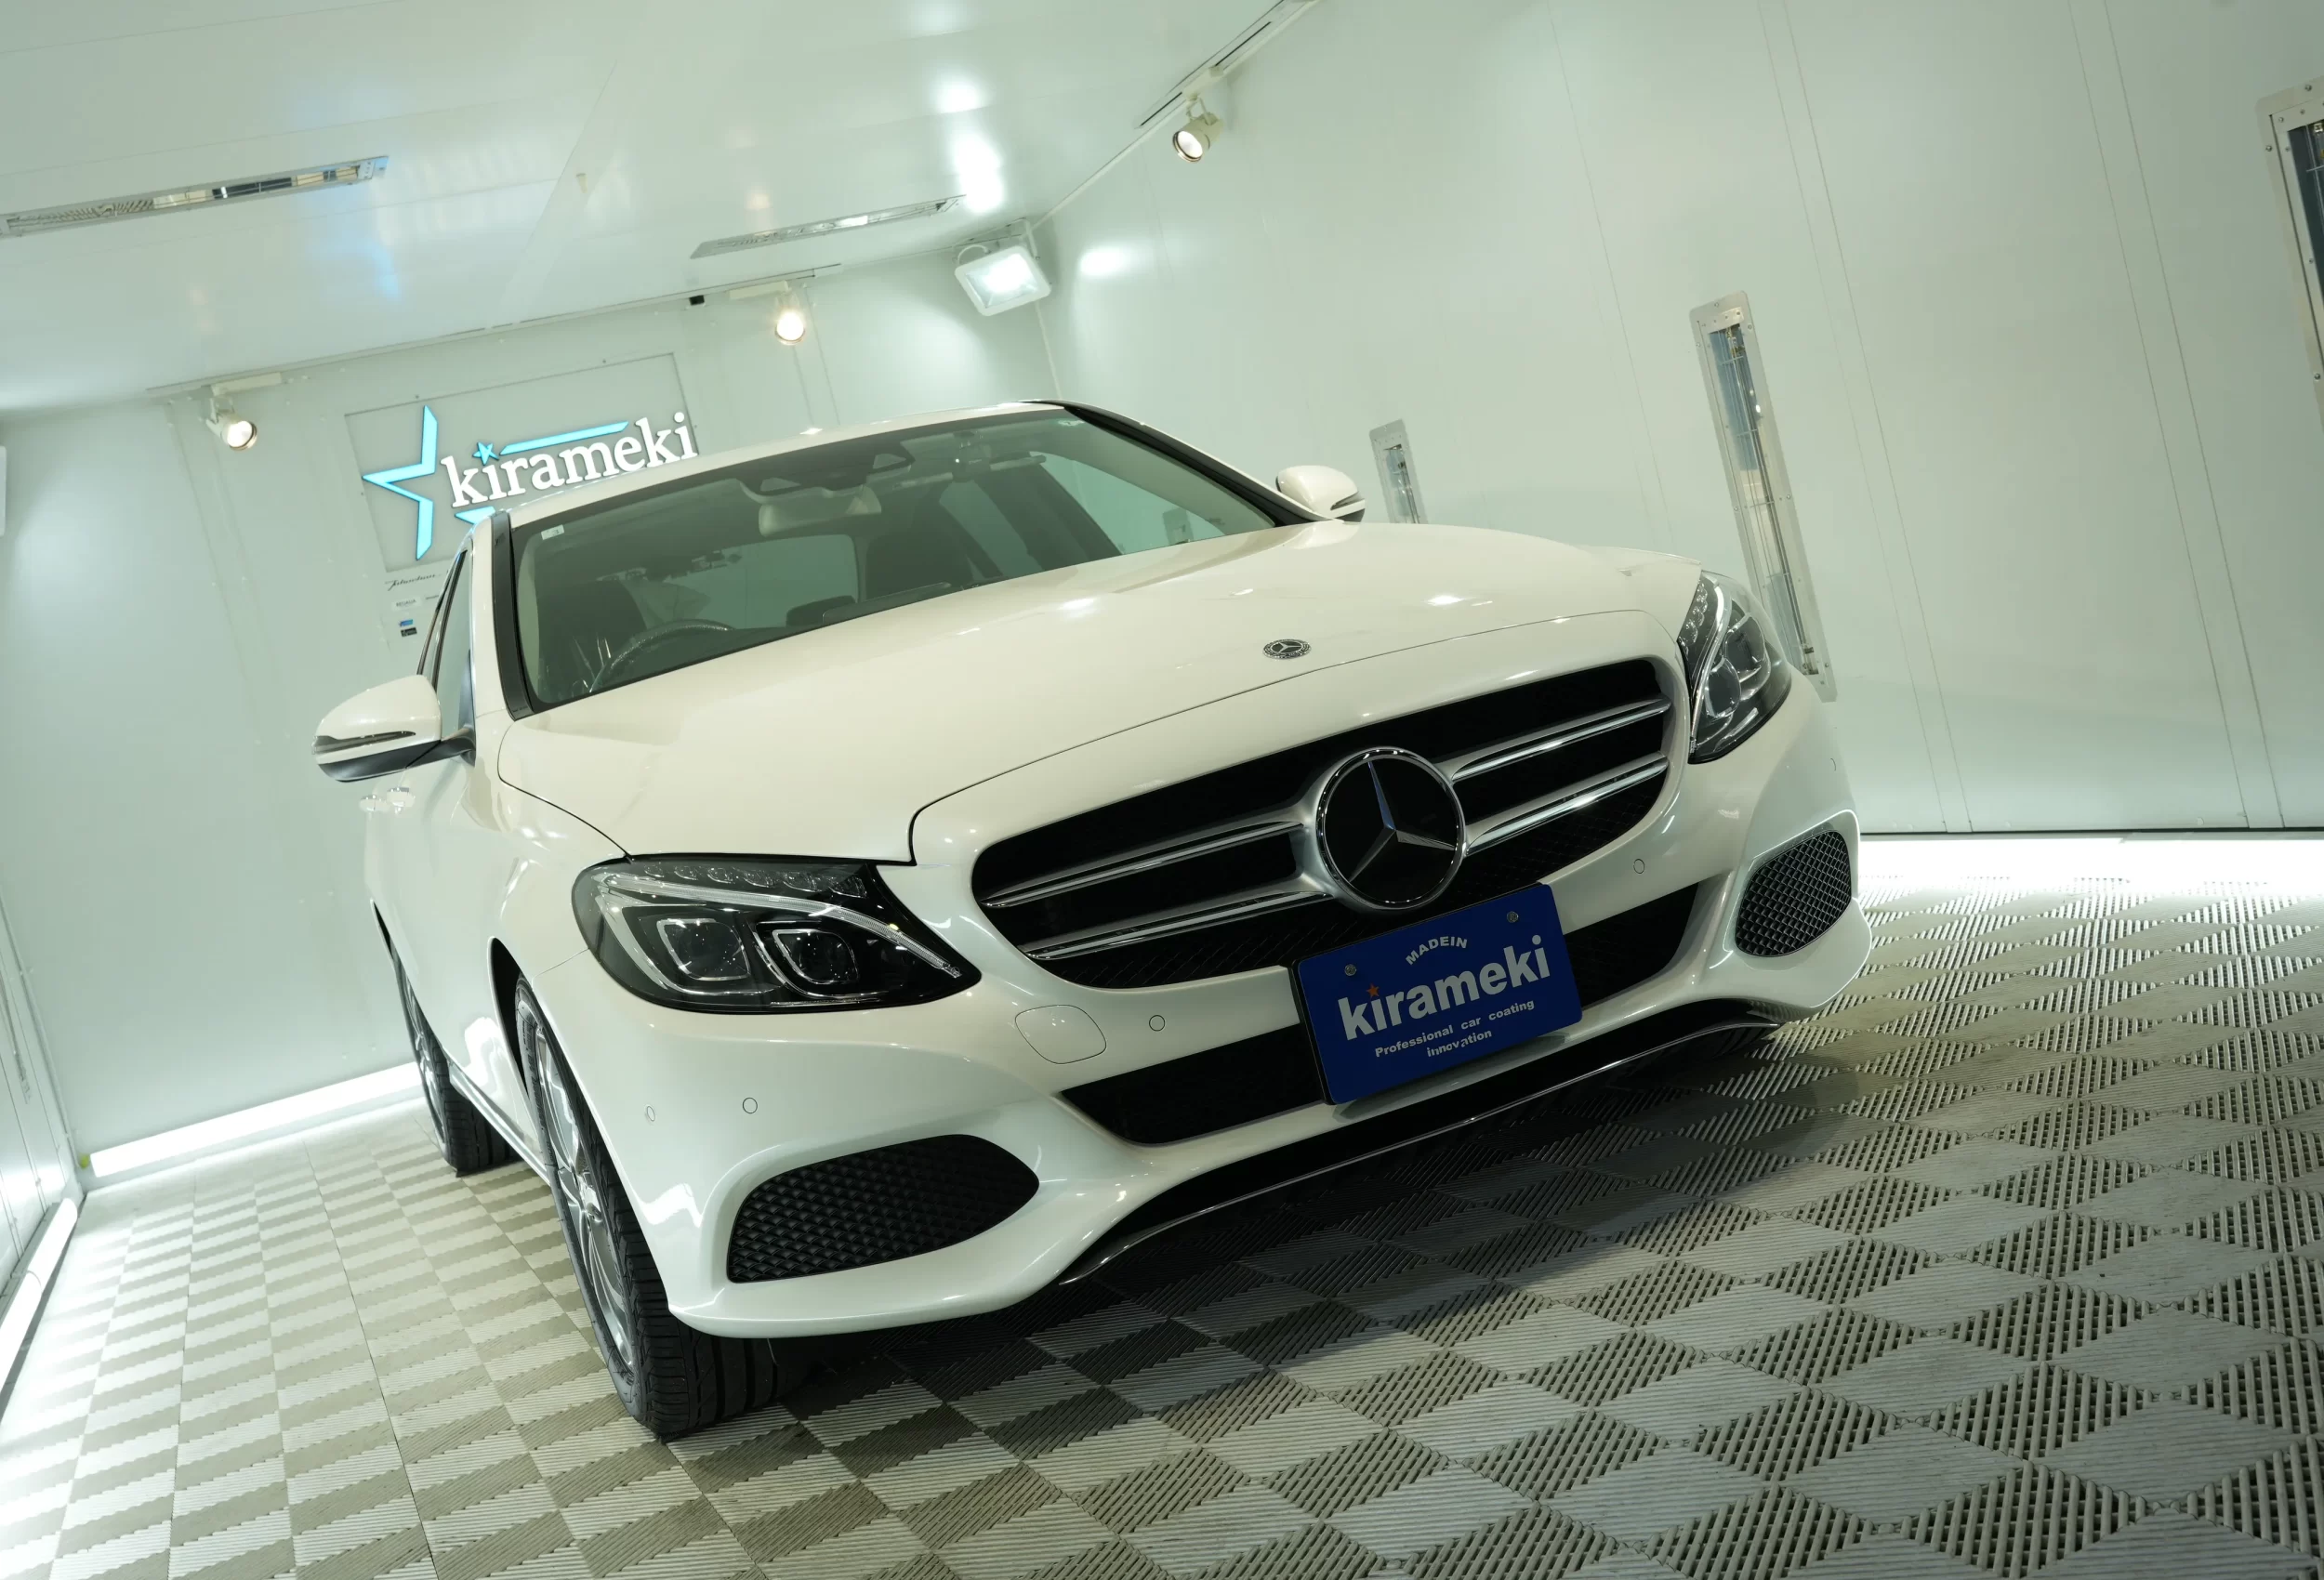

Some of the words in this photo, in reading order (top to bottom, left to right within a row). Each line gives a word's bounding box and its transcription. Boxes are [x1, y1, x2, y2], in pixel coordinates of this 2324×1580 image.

[441, 412, 699, 507] kirameki
[1405, 936, 1468, 966] MADEIN
[1337, 934, 1551, 1041] kirameki
[1375, 1024, 1454, 1058] Professional
[1460, 1016, 1482, 1031] car
[1488, 1000, 1535, 1020] coating
[1426, 1029, 1493, 1058] innovation
